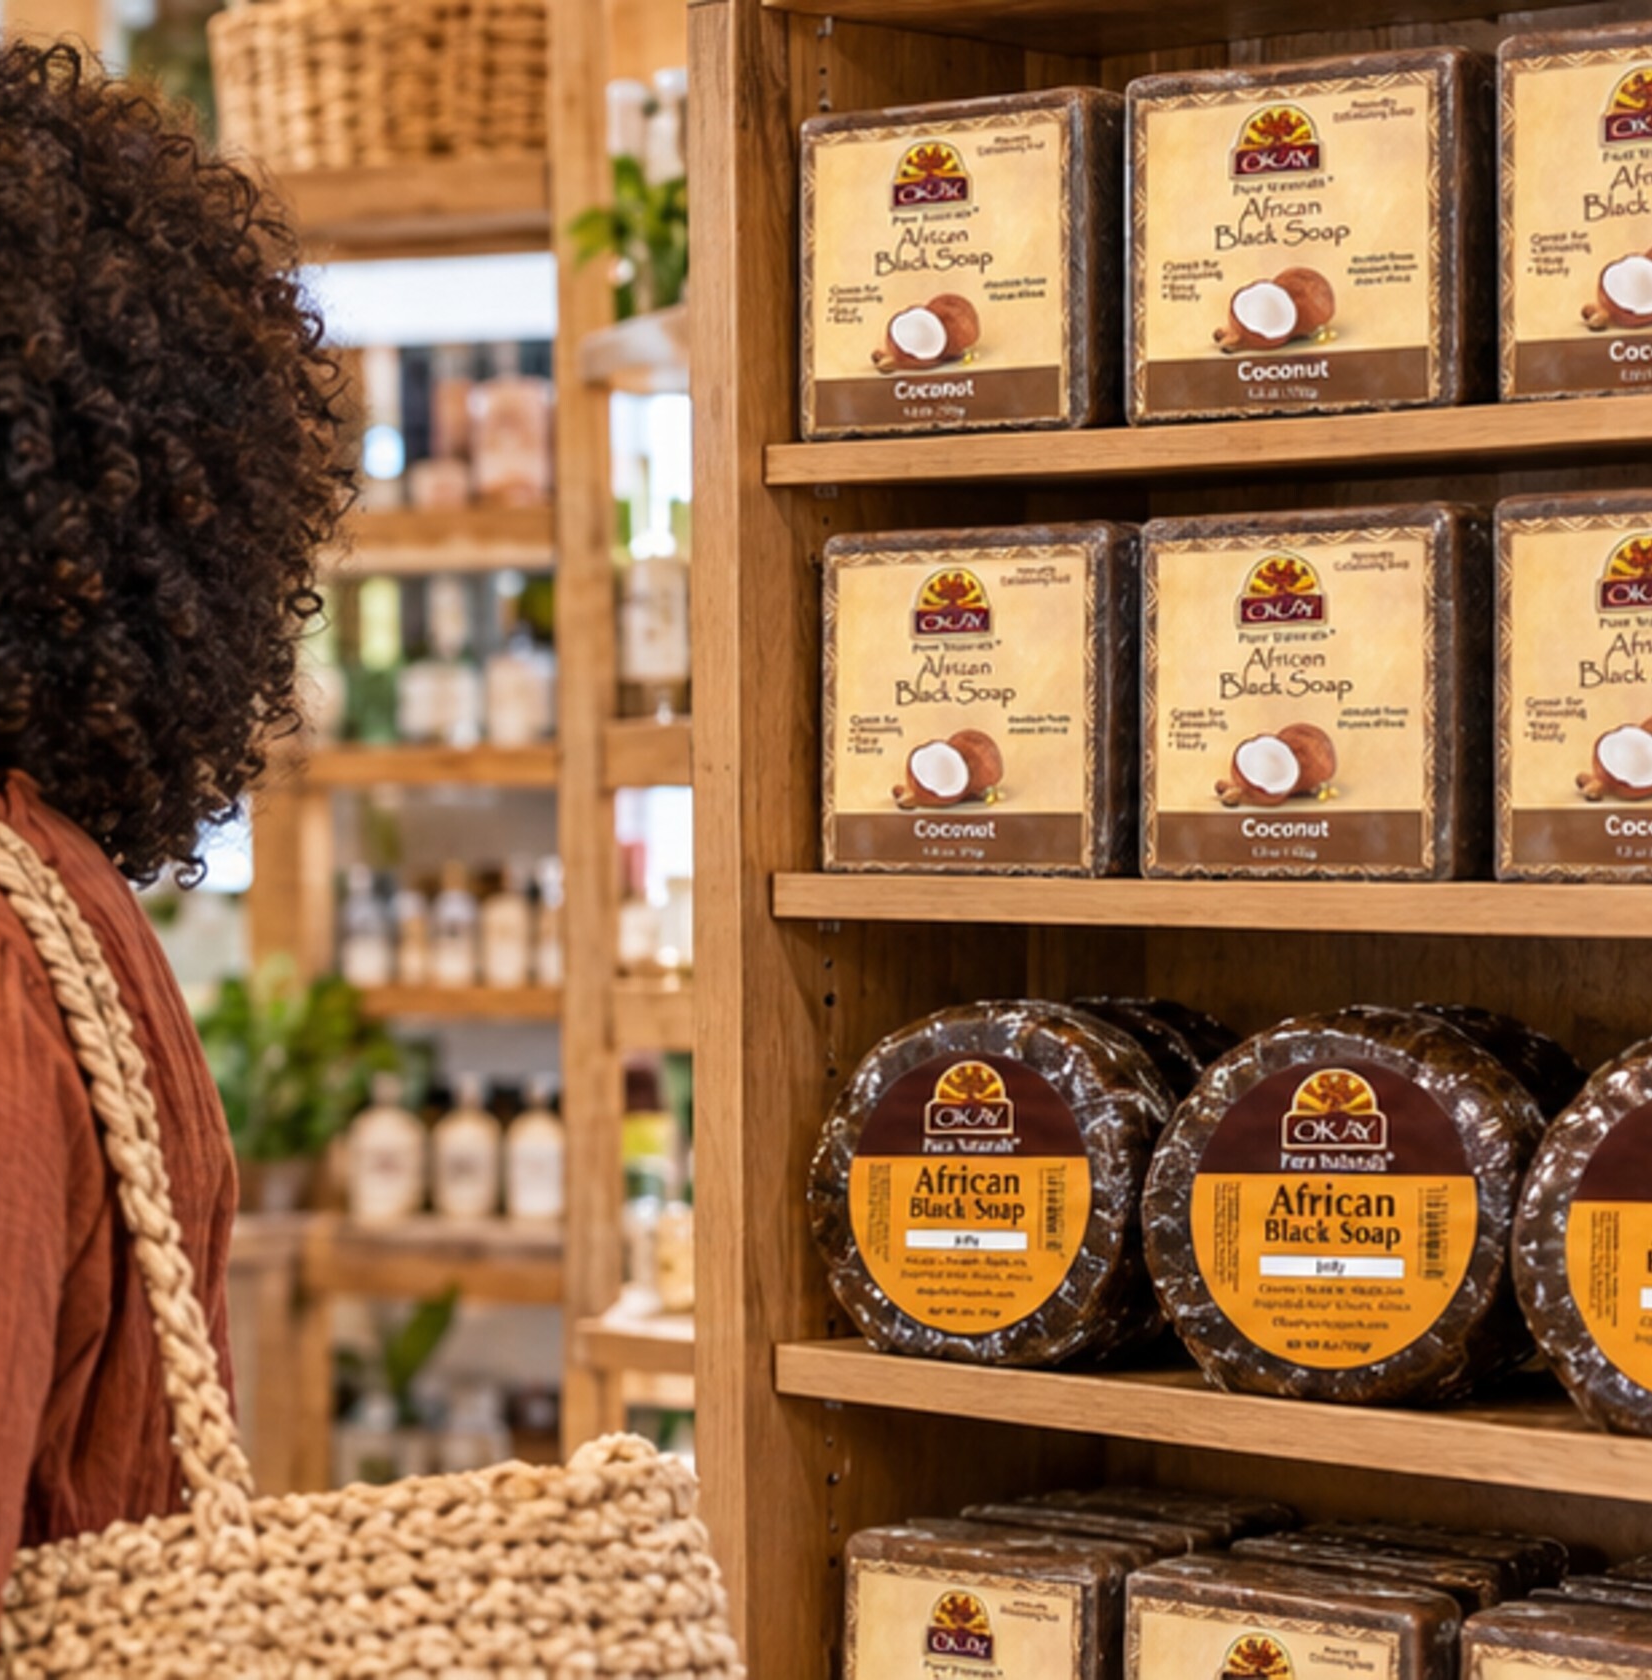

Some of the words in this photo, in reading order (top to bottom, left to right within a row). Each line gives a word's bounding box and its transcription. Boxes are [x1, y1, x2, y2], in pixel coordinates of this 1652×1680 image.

[1240, 197, 1322, 223] African
[1584, 192, 1650, 223] Black
[1214, 223, 1277, 250] Black
[1282, 219, 1351, 246] Soap
[933, 248, 993, 274] Soap
[1237, 360, 1330, 381] Coconut
[1286, 671, 1354, 700] Soap
[1579, 658, 1646, 689] Black
[955, 680, 1017, 707] Soap
[1241, 819, 1329, 838] Coconut
[1294, 1120, 1377, 1142] OKAY
[915, 1166, 1020, 1195] African
[975, 1199, 1026, 1226] Soap
[1268, 1183, 1396, 1218] African
[1265, 1219, 1330, 1244] Black
[1339, 1222, 1401, 1250] Soap
